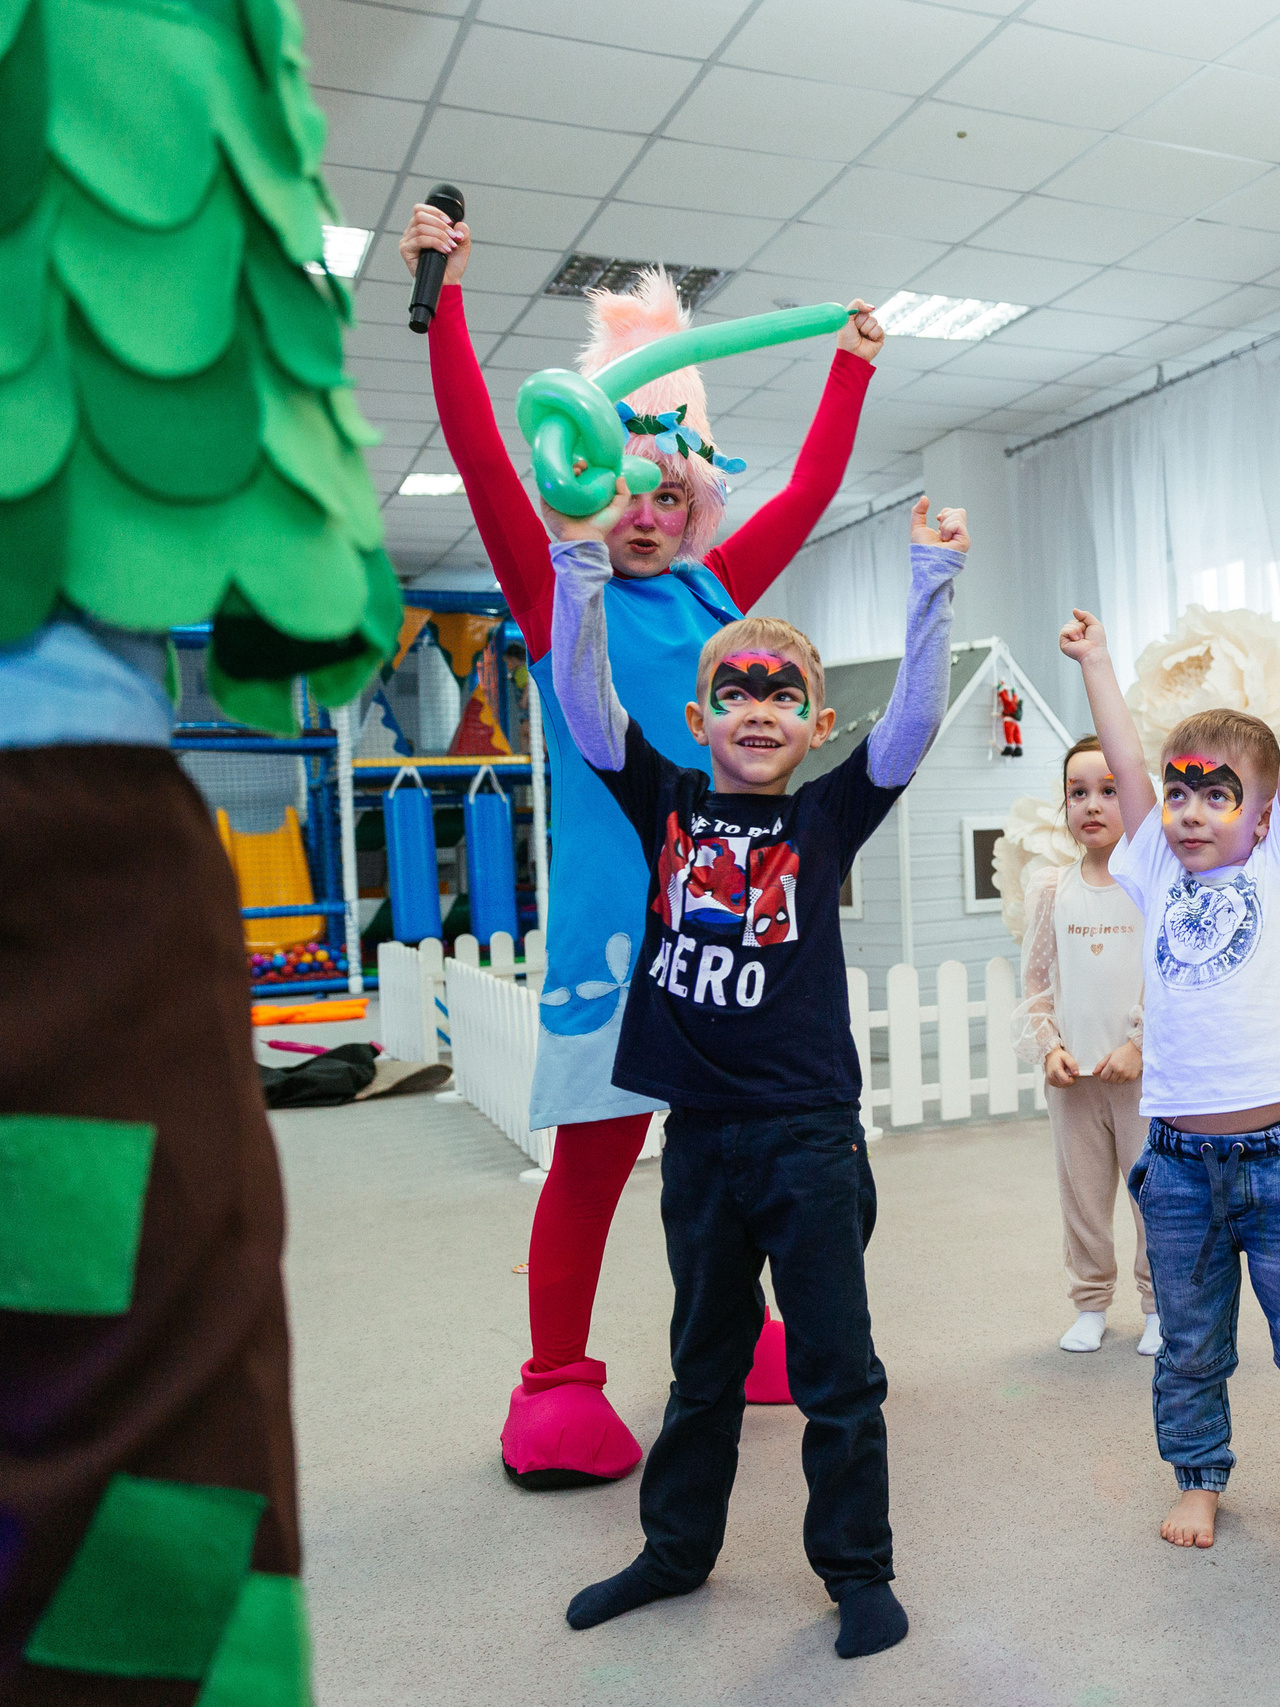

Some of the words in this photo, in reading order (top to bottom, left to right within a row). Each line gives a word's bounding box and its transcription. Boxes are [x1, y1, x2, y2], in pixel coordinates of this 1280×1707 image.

[714, 819, 741, 834] TO
[1067, 924, 1134, 937] Happiness
[648, 933, 765, 1007] HERO
[1199, 946, 1243, 980] DEPT
